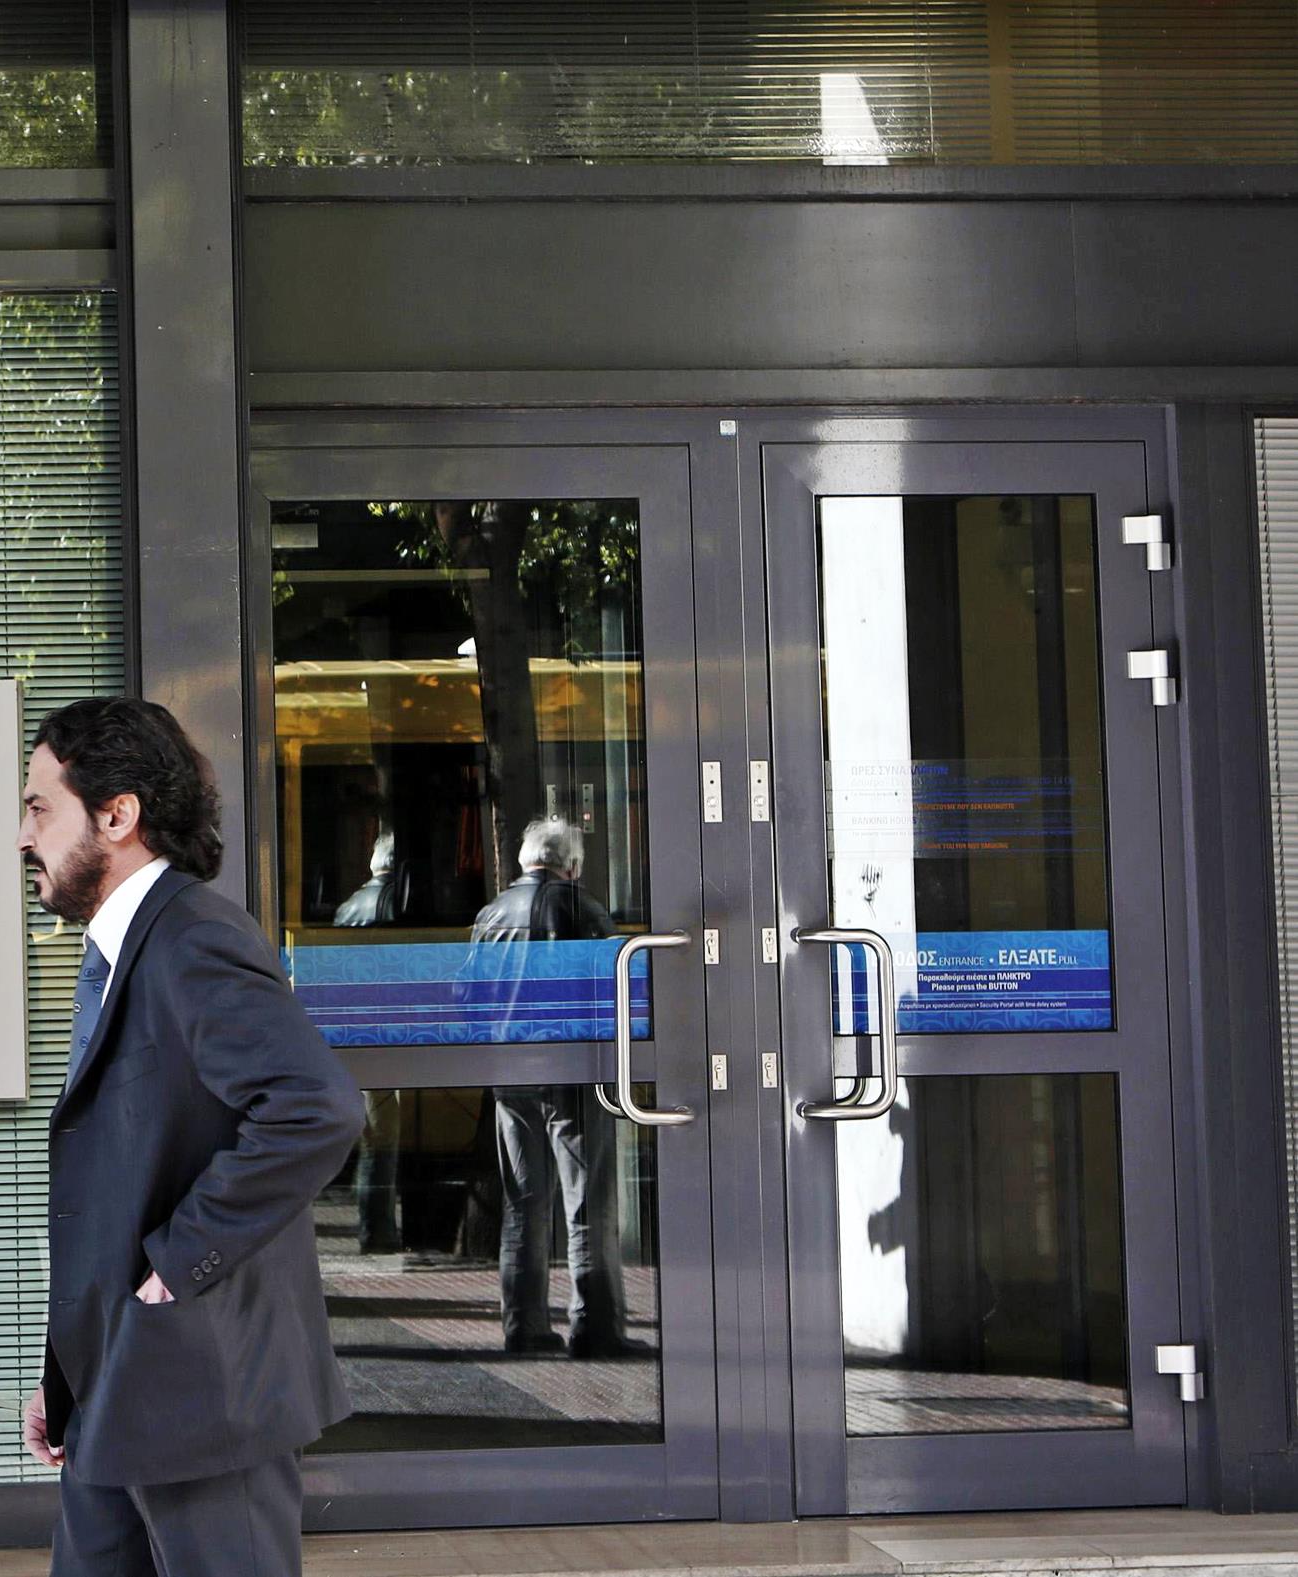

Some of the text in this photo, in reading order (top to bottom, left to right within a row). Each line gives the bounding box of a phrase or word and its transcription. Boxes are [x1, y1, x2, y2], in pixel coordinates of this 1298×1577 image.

[892, 949, 1078, 966] ΟΔΟΣ ENTRANCE ΕΛΞΑΤΕ PULL
[996, 971, 1031, 981] ΠΛΗΚΤΡΟ
[931, 983, 955, 991] Please
[976, 983, 988, 991] the
[988, 982, 1018, 991] BUTTON
